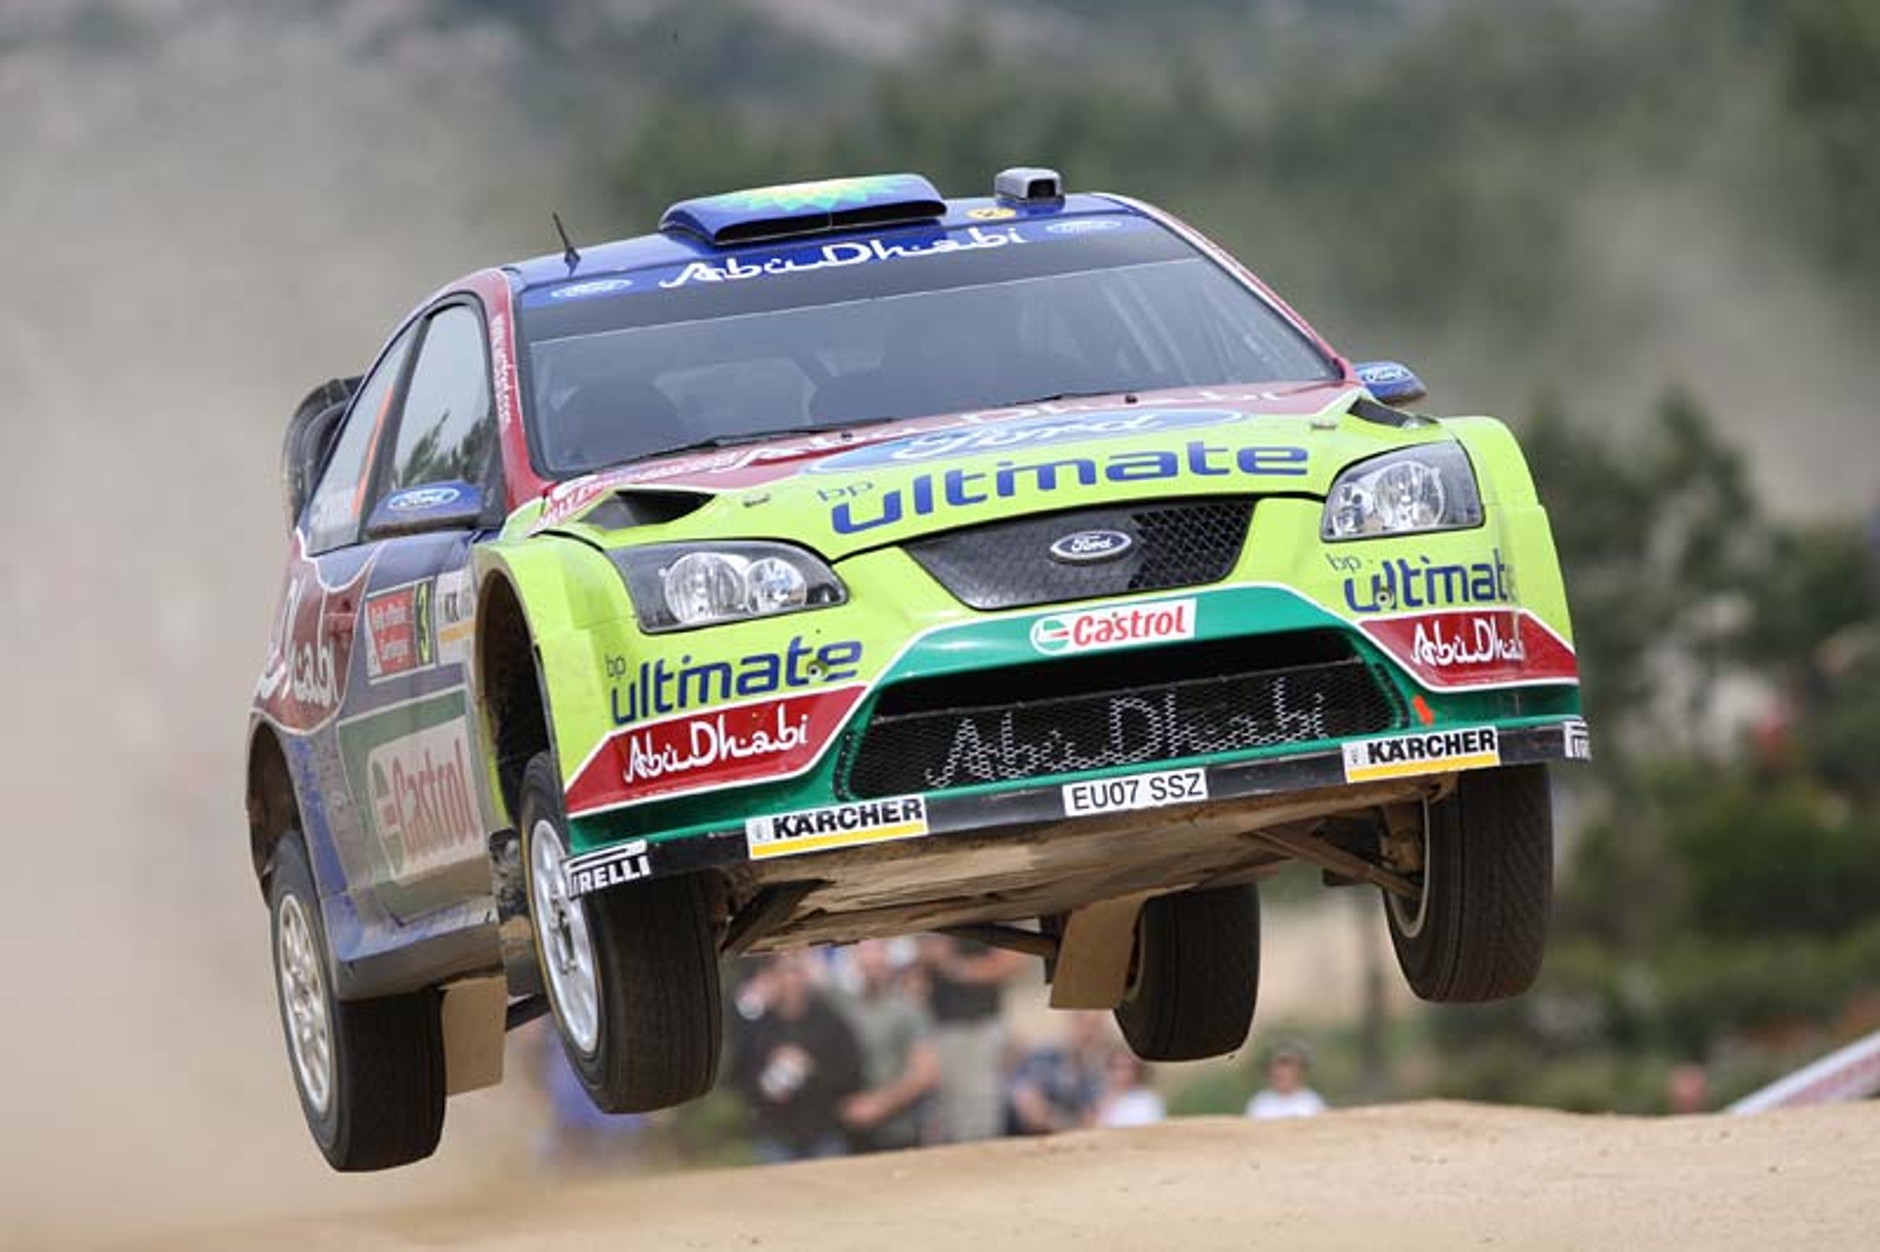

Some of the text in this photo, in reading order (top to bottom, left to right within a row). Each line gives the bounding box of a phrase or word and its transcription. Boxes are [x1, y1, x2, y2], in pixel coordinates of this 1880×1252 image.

[659, 256, 815, 289] Abu
[816, 226, 1028, 270] Dhabi
[892, 413, 1166, 461] Ford
[817, 481, 874, 502] bp
[831, 440, 1308, 535] ultimate
[1326, 552, 1361, 572] bp
[1344, 547, 1517, 613] ultimat
[1074, 604, 1185, 647] Castrol
[1411, 616, 1468, 665] Abu
[605, 654, 626, 680] bp
[610, 635, 863, 725] ultimate
[624, 703, 809, 783] Abu Dhabi
[924, 676, 1329, 789] Abu Dhabi
[1367, 729, 1496, 764] KÄRCHER
[1072, 772, 1204, 811] EU07 SSZ
[772, 798, 923, 840] KÄRCHER
